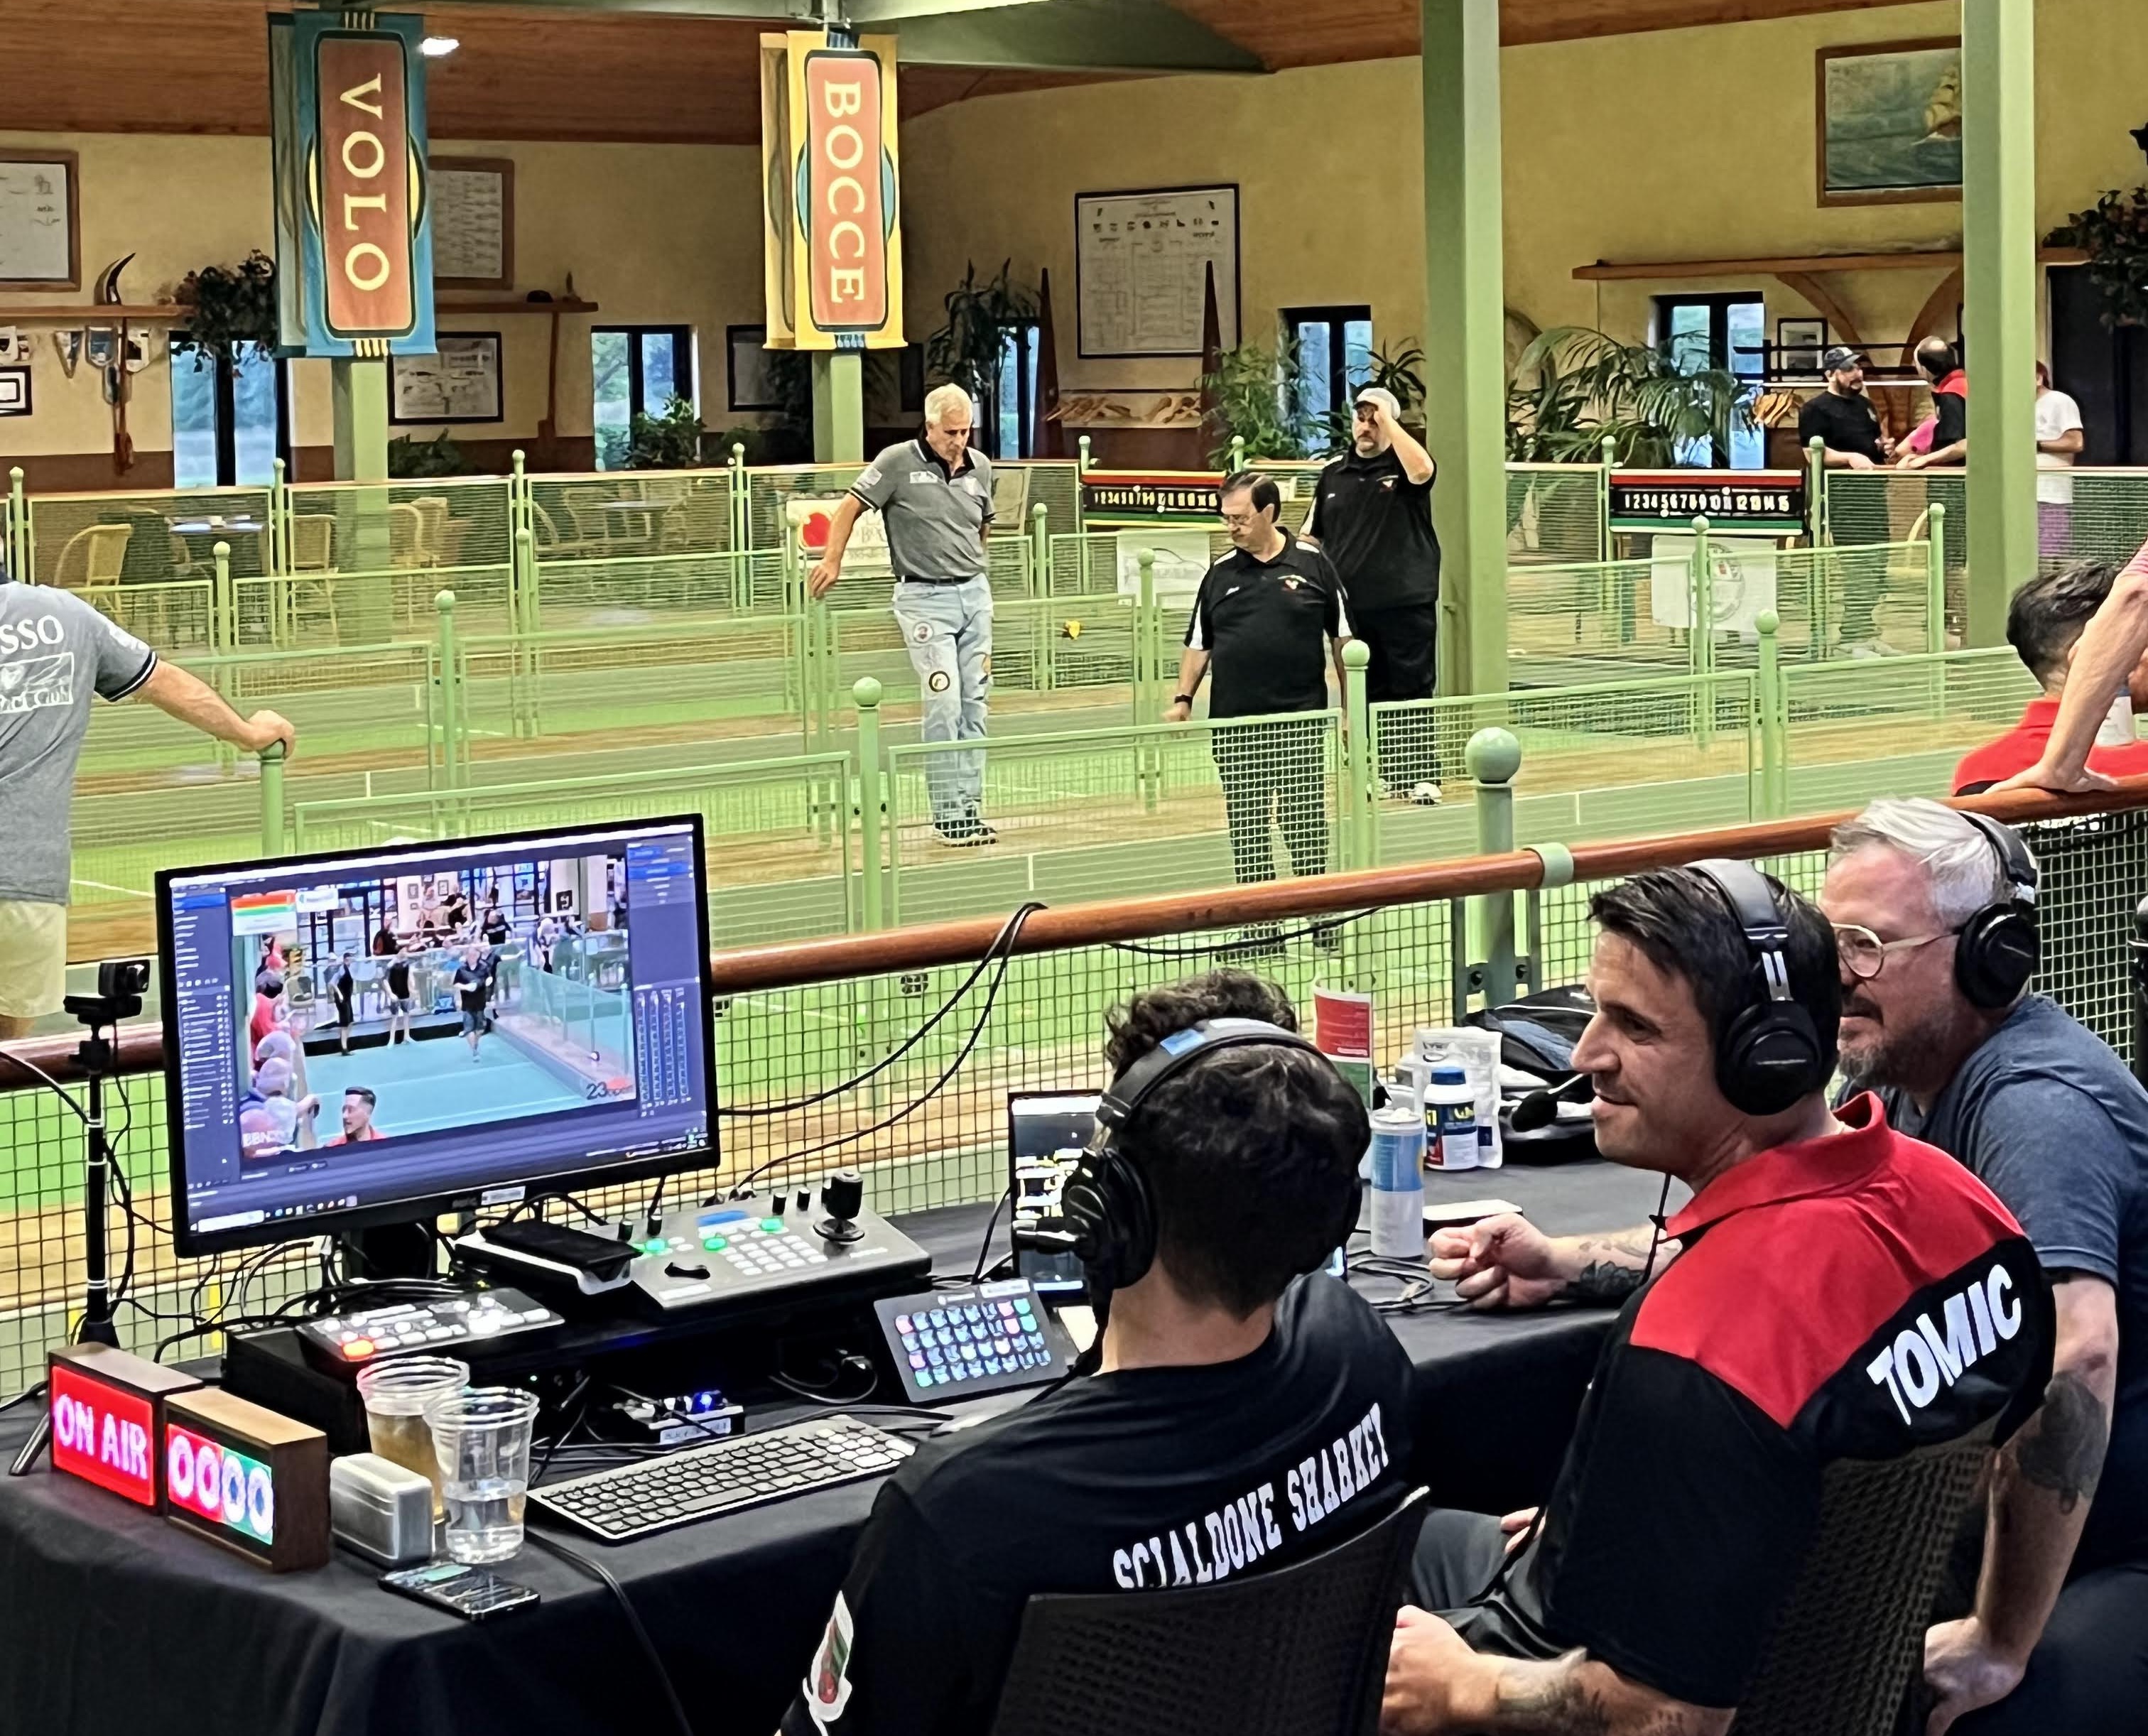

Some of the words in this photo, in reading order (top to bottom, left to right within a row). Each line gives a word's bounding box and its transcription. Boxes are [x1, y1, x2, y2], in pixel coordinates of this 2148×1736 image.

[340, 72, 389, 291] VOLO
[824, 80, 865, 303] BOCCE
[1866, 1264, 2022, 1425] TOMIC
[54, 1394, 94, 1455] ON
[101, 1413, 147, 1480] AIR
[1113, 1482, 1282, 1588] SCIALDONE
